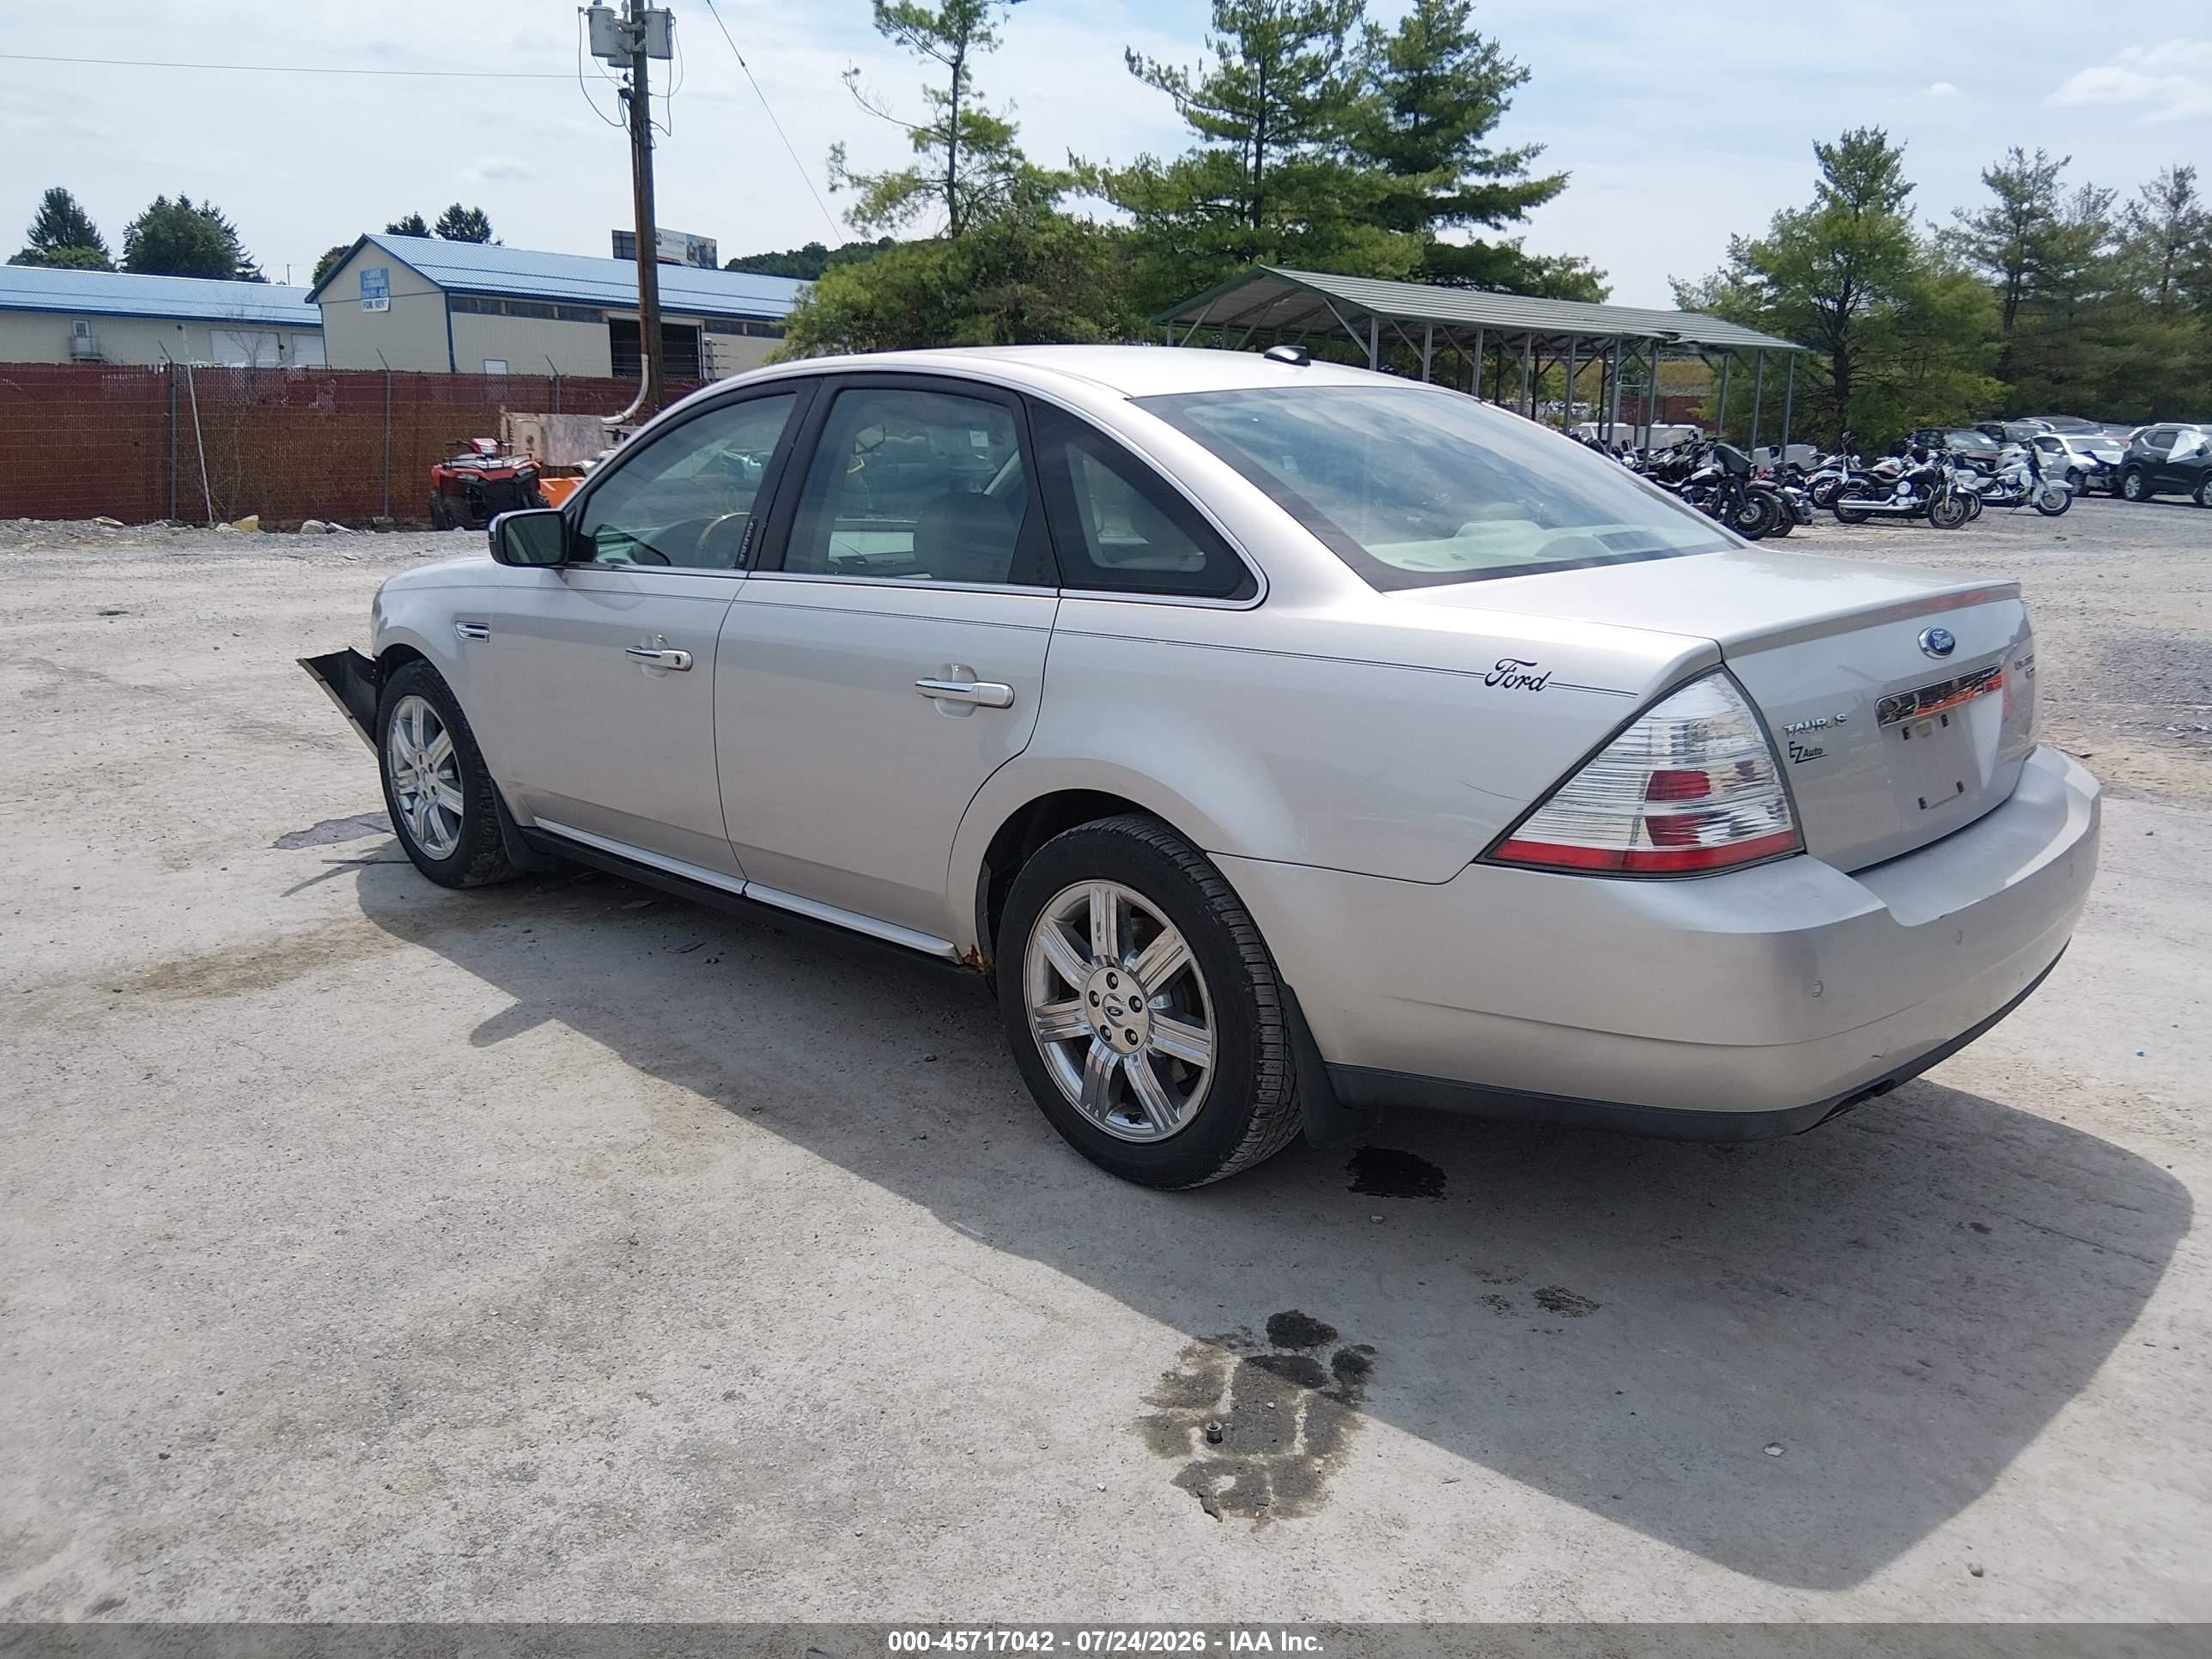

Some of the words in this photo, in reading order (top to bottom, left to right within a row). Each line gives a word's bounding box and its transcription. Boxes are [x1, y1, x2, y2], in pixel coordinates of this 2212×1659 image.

[363, 301, 373, 309] FOR
[375, 300, 387, 308] RENT
[1485, 658, 1553, 691] Ford
[1803, 747, 1822, 757] Auto
